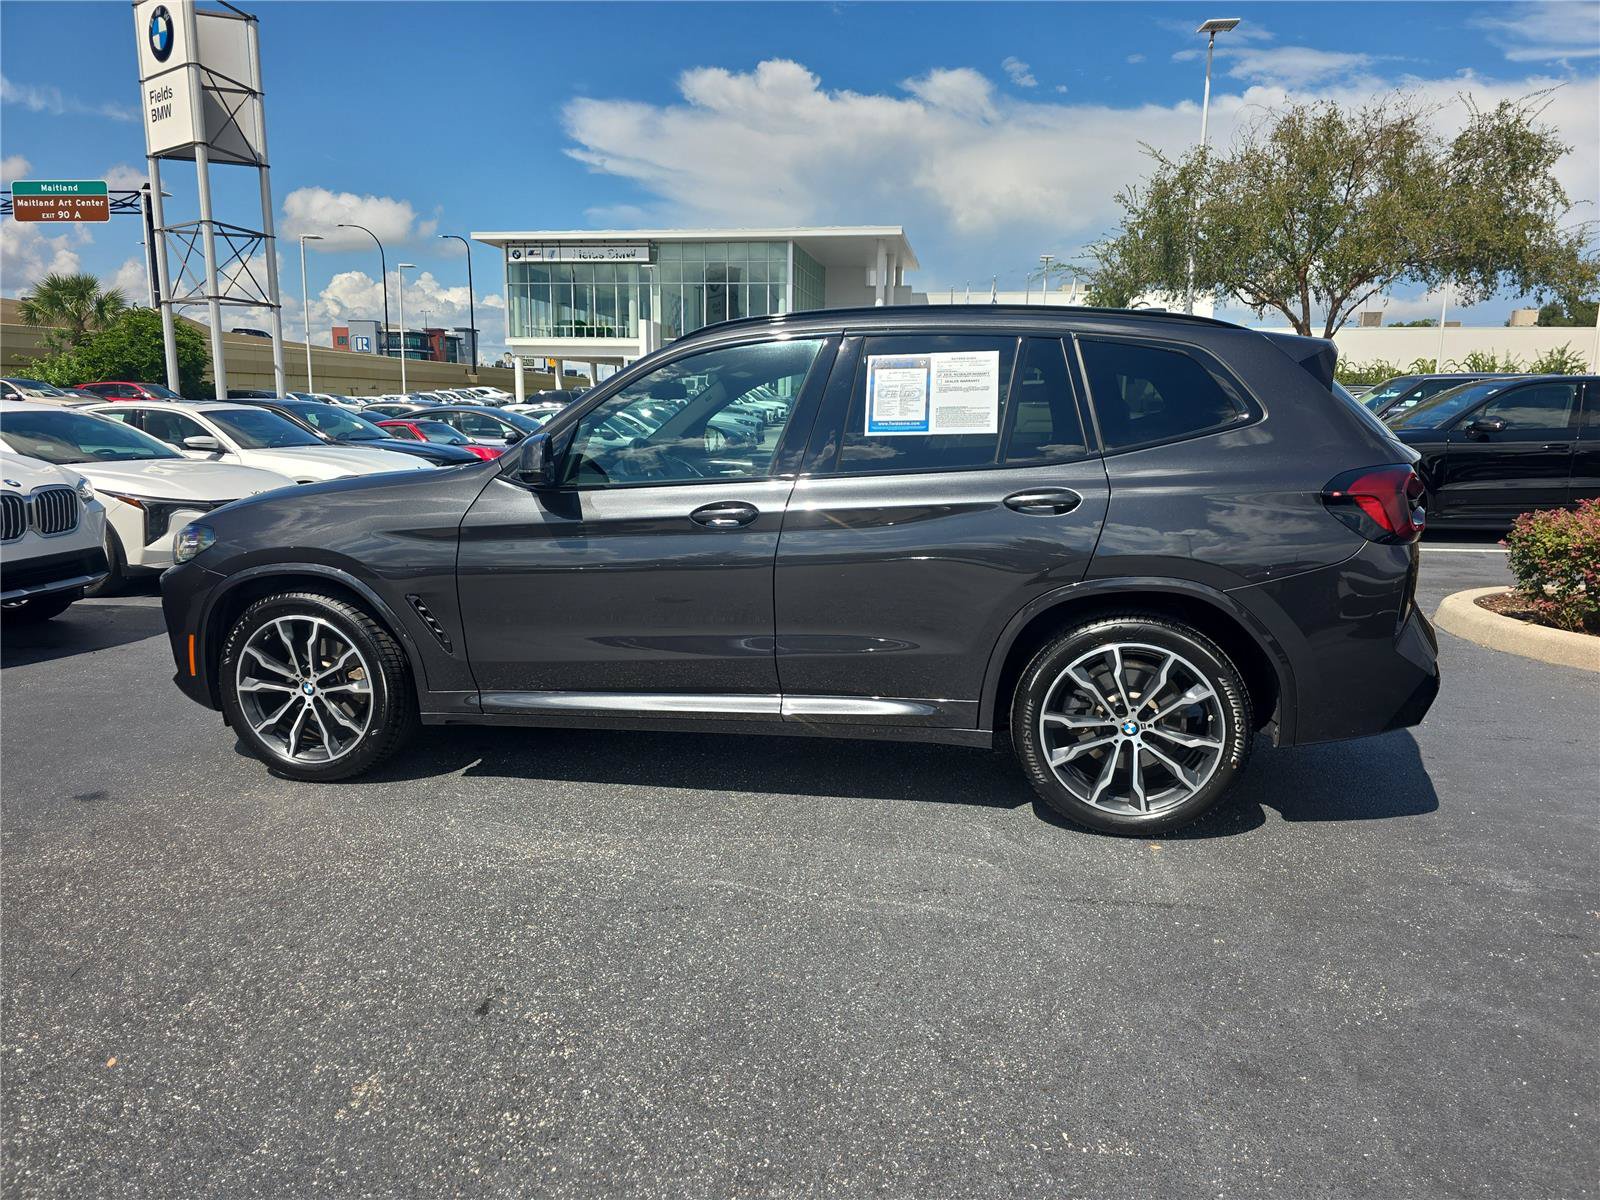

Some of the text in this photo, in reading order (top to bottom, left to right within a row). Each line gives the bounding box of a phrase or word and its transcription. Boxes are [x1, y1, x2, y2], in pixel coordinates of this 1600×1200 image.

[150, 86, 173, 105] Fields
[151, 104, 172, 123] BMW
[58, 210, 70, 218] 90
[74, 210, 81, 219] A
[1217, 676, 1247, 769] BRIDGESTONE
[1020, 698, 1048, 785] BRIDGESTONE
